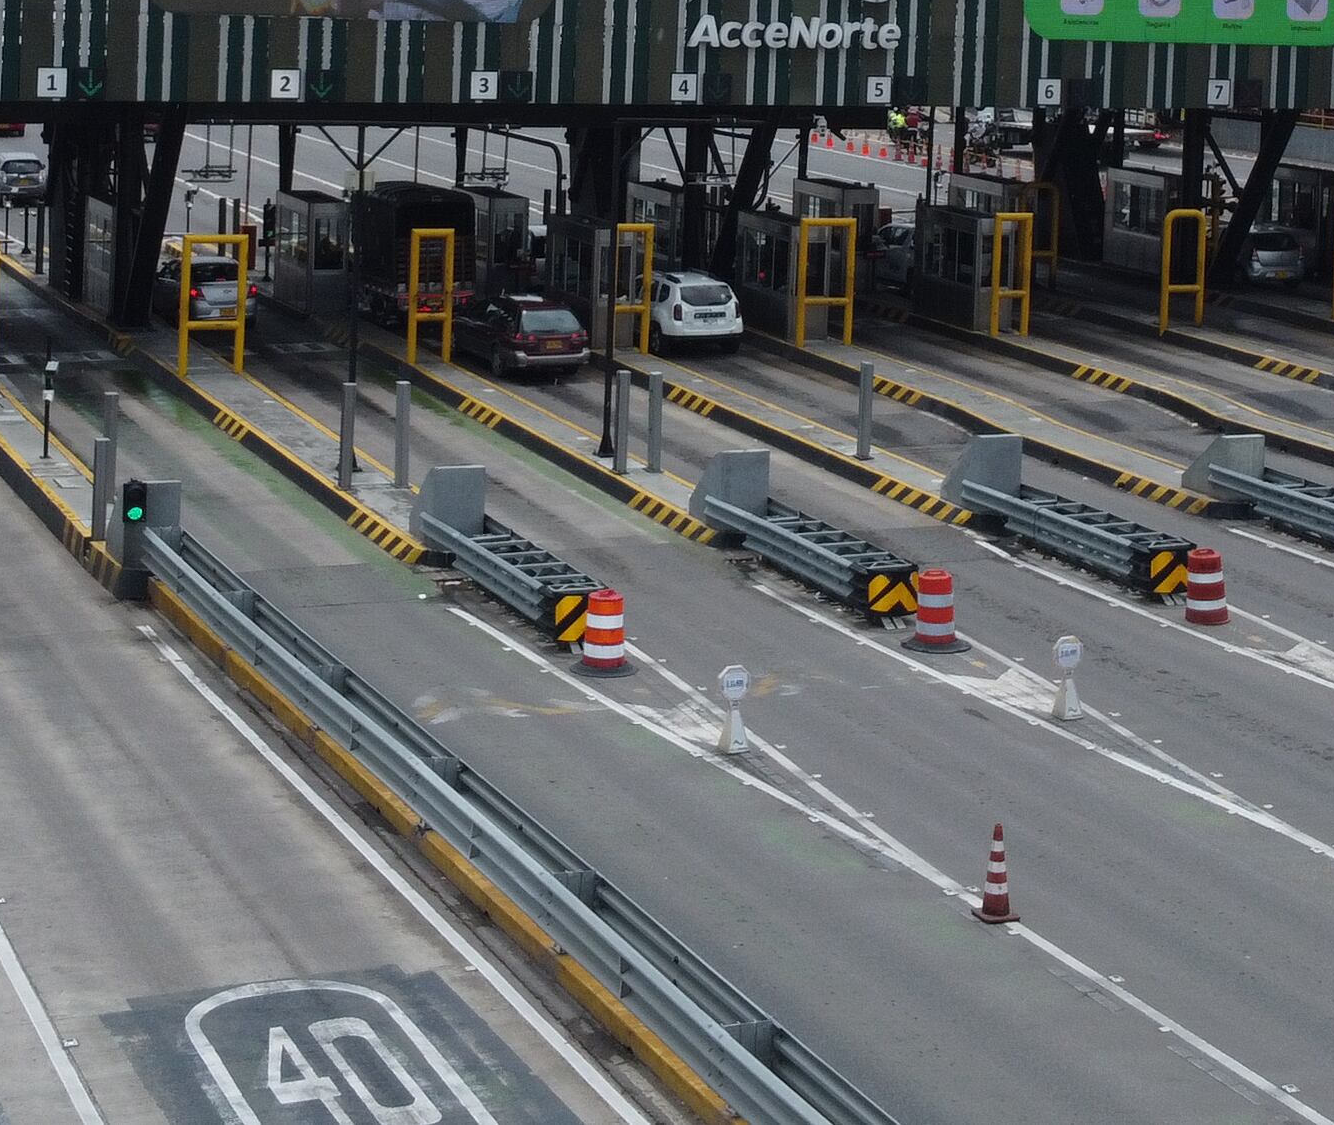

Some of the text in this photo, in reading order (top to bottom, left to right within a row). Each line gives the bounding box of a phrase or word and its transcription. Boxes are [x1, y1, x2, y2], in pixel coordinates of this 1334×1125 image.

[687, 14, 902, 50] AcceNorte
[46, 75, 57, 91] 1
[279, 76, 291, 92] 2
[478, 78, 489, 94] 3
[678, 79, 689, 95] 4
[874, 82, 884, 98] 5
[1043, 83, 1054, 99] 6
[1213, 83, 1223, 99] 7
[267, 1016, 442, 1125] 40
